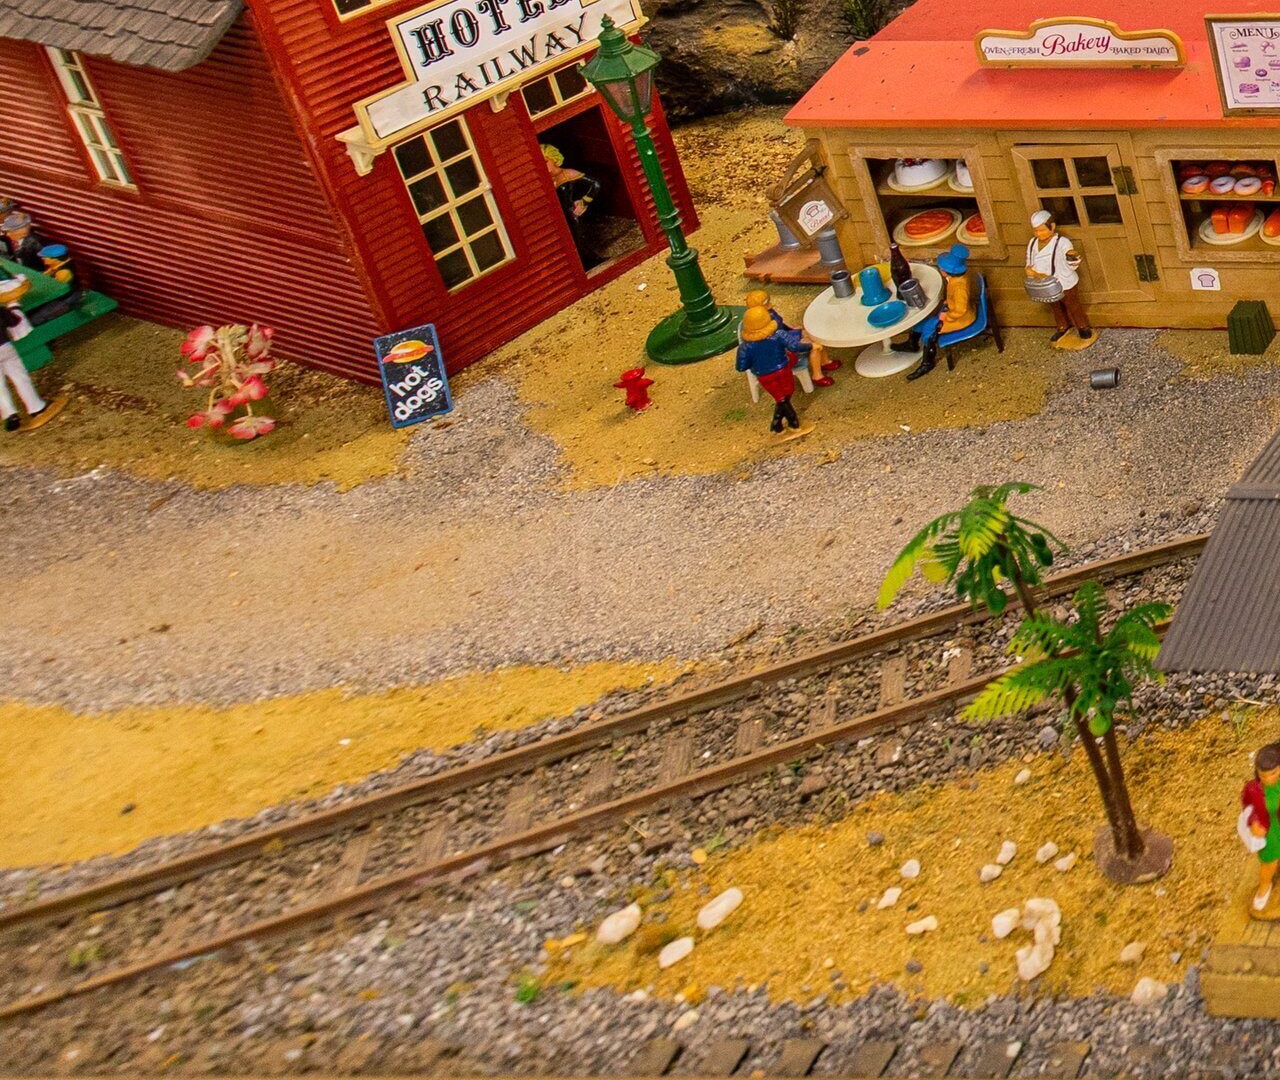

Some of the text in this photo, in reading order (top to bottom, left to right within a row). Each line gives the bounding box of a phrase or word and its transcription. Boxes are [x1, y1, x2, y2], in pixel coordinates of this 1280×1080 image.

[1041, 33, 1111, 57] Bakery
[1110, 47, 1142, 56] BAKED
[1230, 28, 1280, 39] MENU
[422, 12, 588, 112] RAILWAY
[389, 365, 429, 398] hot
[394, 377, 443, 420] dogs
